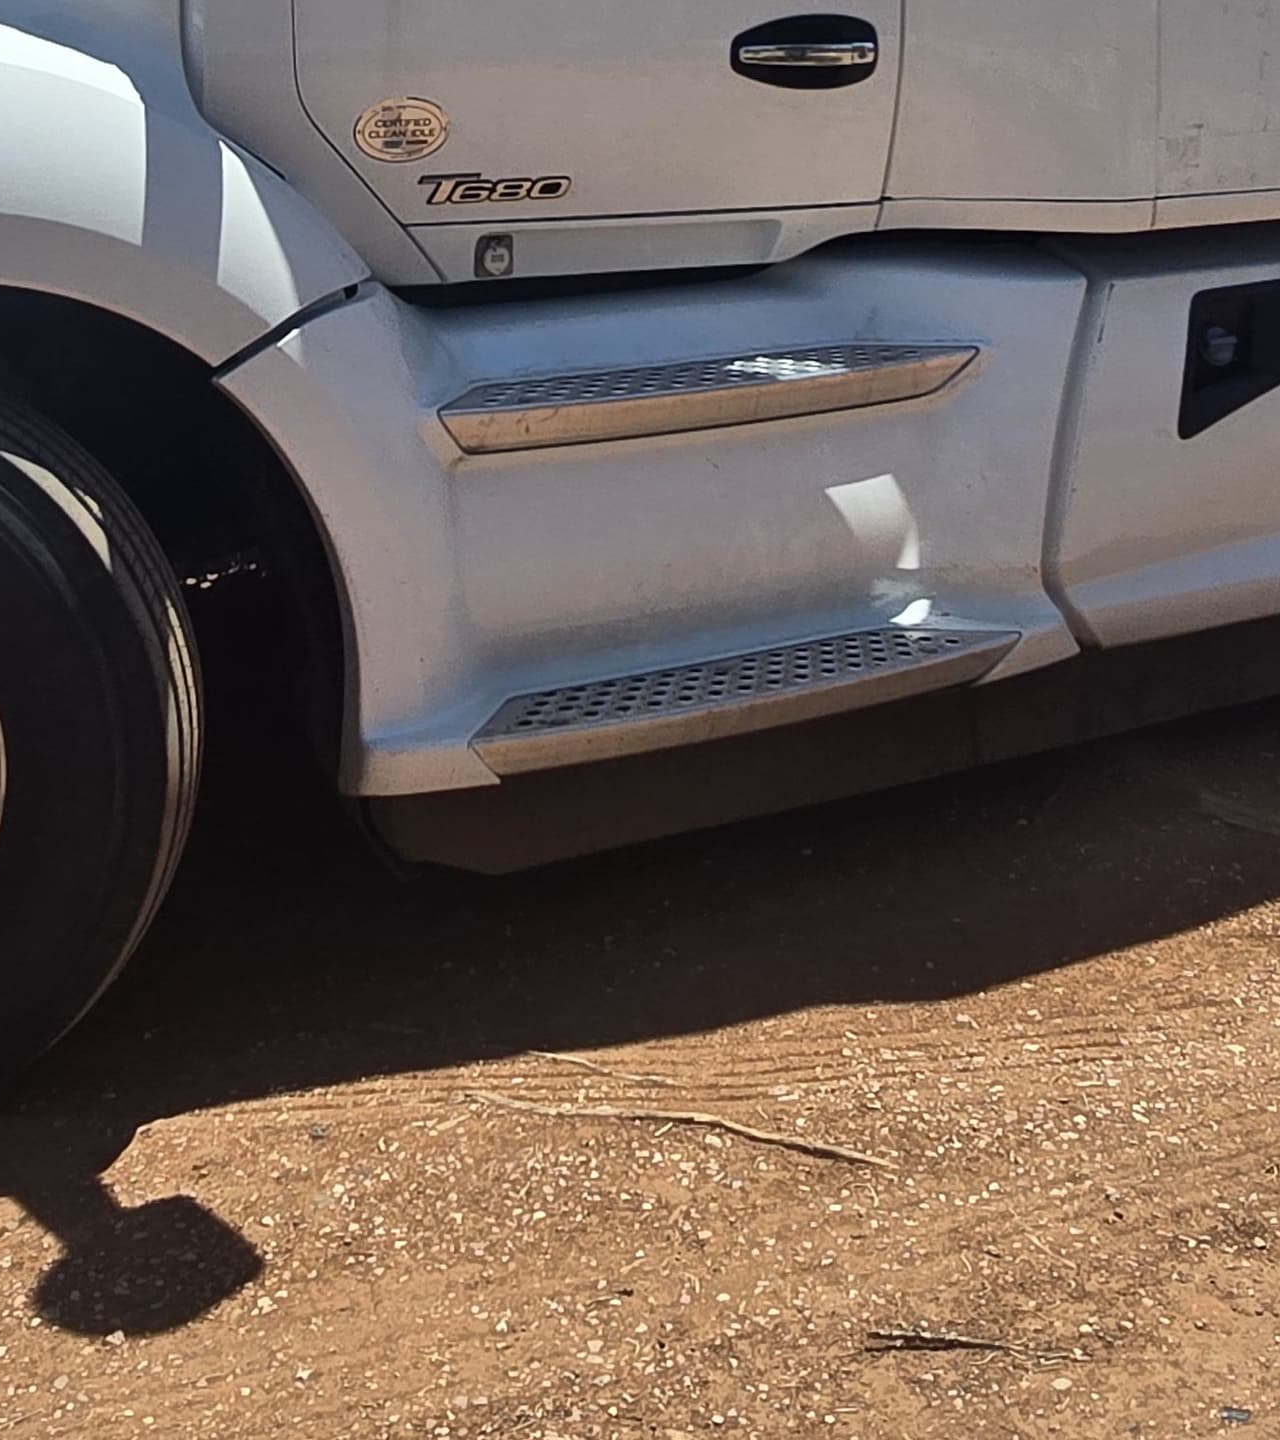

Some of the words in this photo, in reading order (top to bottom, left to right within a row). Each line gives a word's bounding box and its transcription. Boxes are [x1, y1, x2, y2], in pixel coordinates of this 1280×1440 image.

[374, 118, 432, 128] CERTIFIED
[368, 129, 407, 138] CLEAN
[410, 127, 436, 137] IDLE
[417, 172, 572, 205] T680
